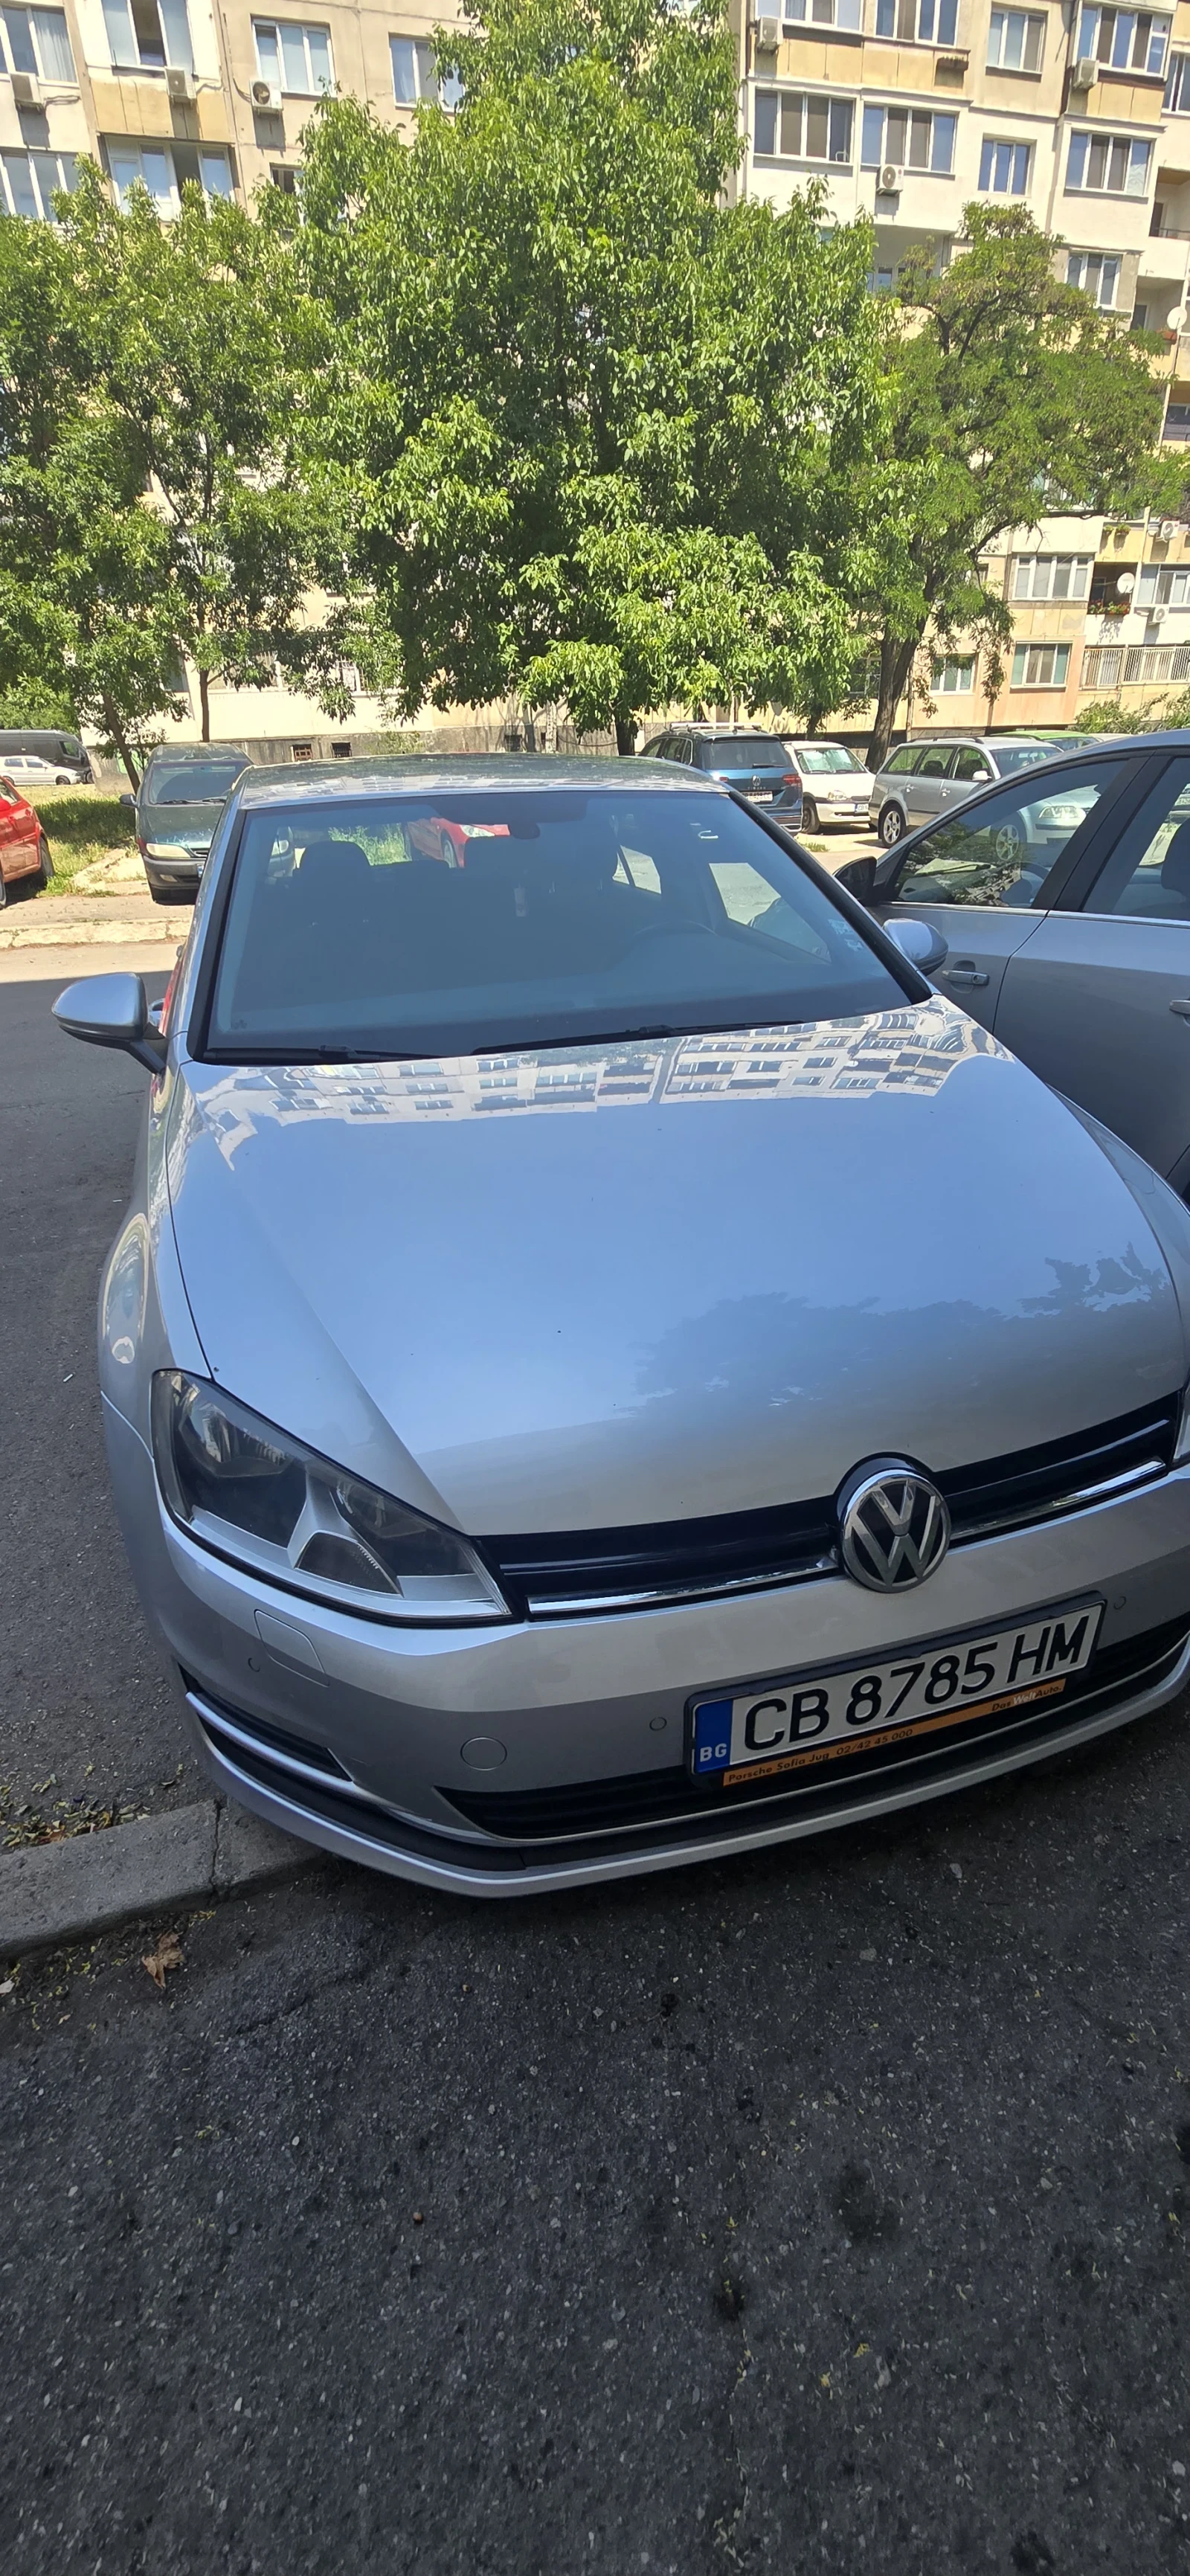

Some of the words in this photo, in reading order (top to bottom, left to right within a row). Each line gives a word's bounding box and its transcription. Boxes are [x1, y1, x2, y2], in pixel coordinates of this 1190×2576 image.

[842, 1468, 951, 1593] VW
[744, 1688, 830, 1751] CB
[845, 1641, 999, 1726] 8785
[1006, 1615, 1090, 1683] HM
[991, 1701, 1011, 1712] Das
[699, 1743, 727, 1763] BG
[728, 1767, 773, 1783] Porsche
[776, 1757, 805, 1771] Sofia
[836, 1740, 871, 1756] 02/42
[874, 1736, 888, 1744] 45
[891, 1728, 913, 1741] 000
